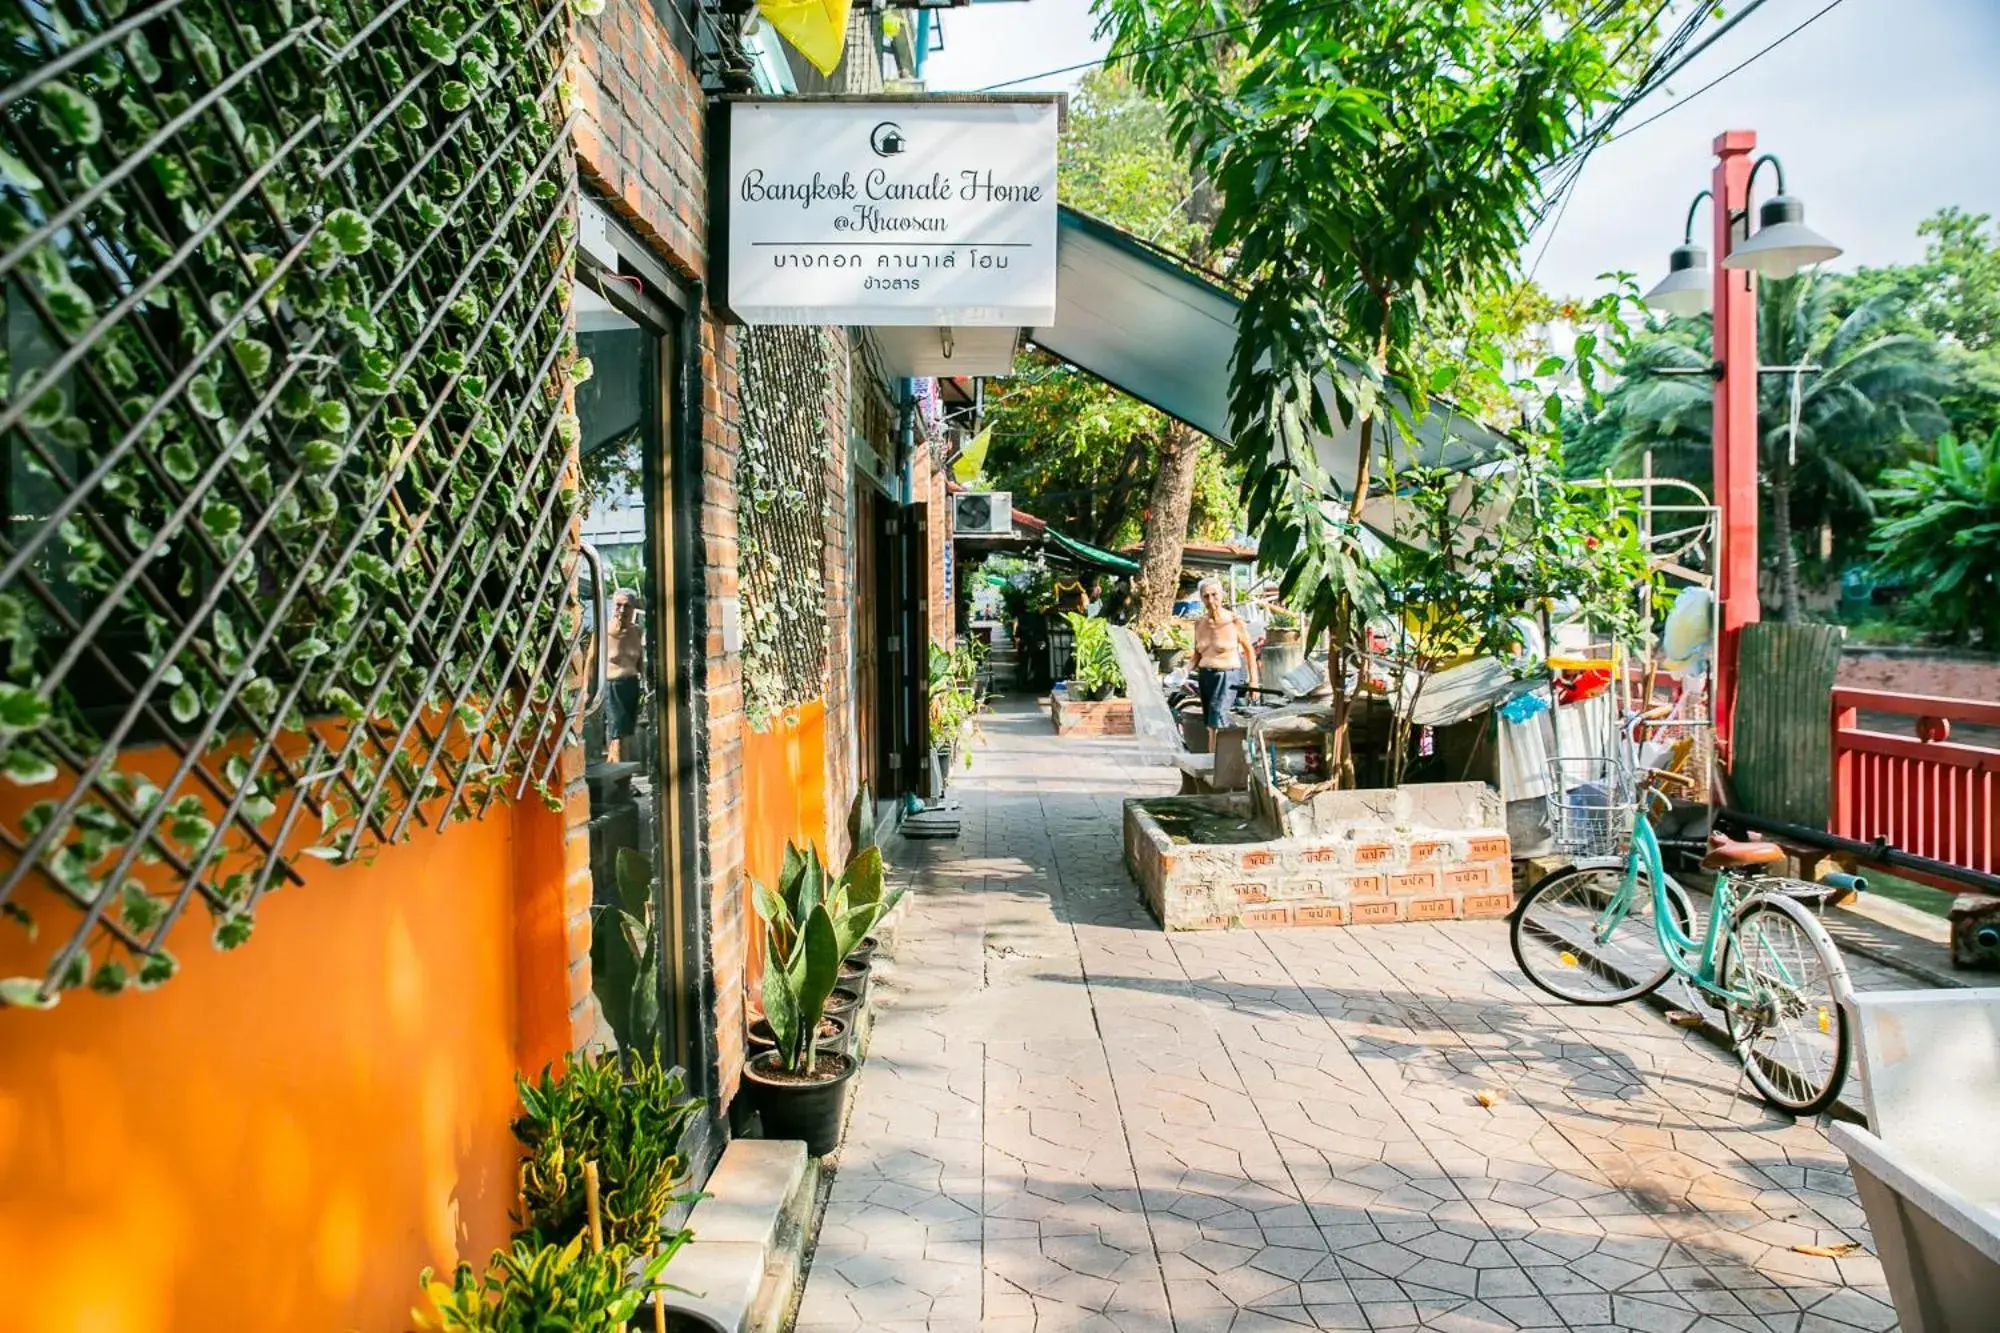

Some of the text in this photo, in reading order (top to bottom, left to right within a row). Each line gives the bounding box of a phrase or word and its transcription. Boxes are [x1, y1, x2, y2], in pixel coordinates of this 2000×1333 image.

[741, 168, 1044, 209] Bangkok Canalé Home
[834, 204, 948, 235] @Khaosan
[773, 249, 1009, 269] บางกอก คานาเล่ โฮม
[863, 276, 921, 291] ข้าวสาร
